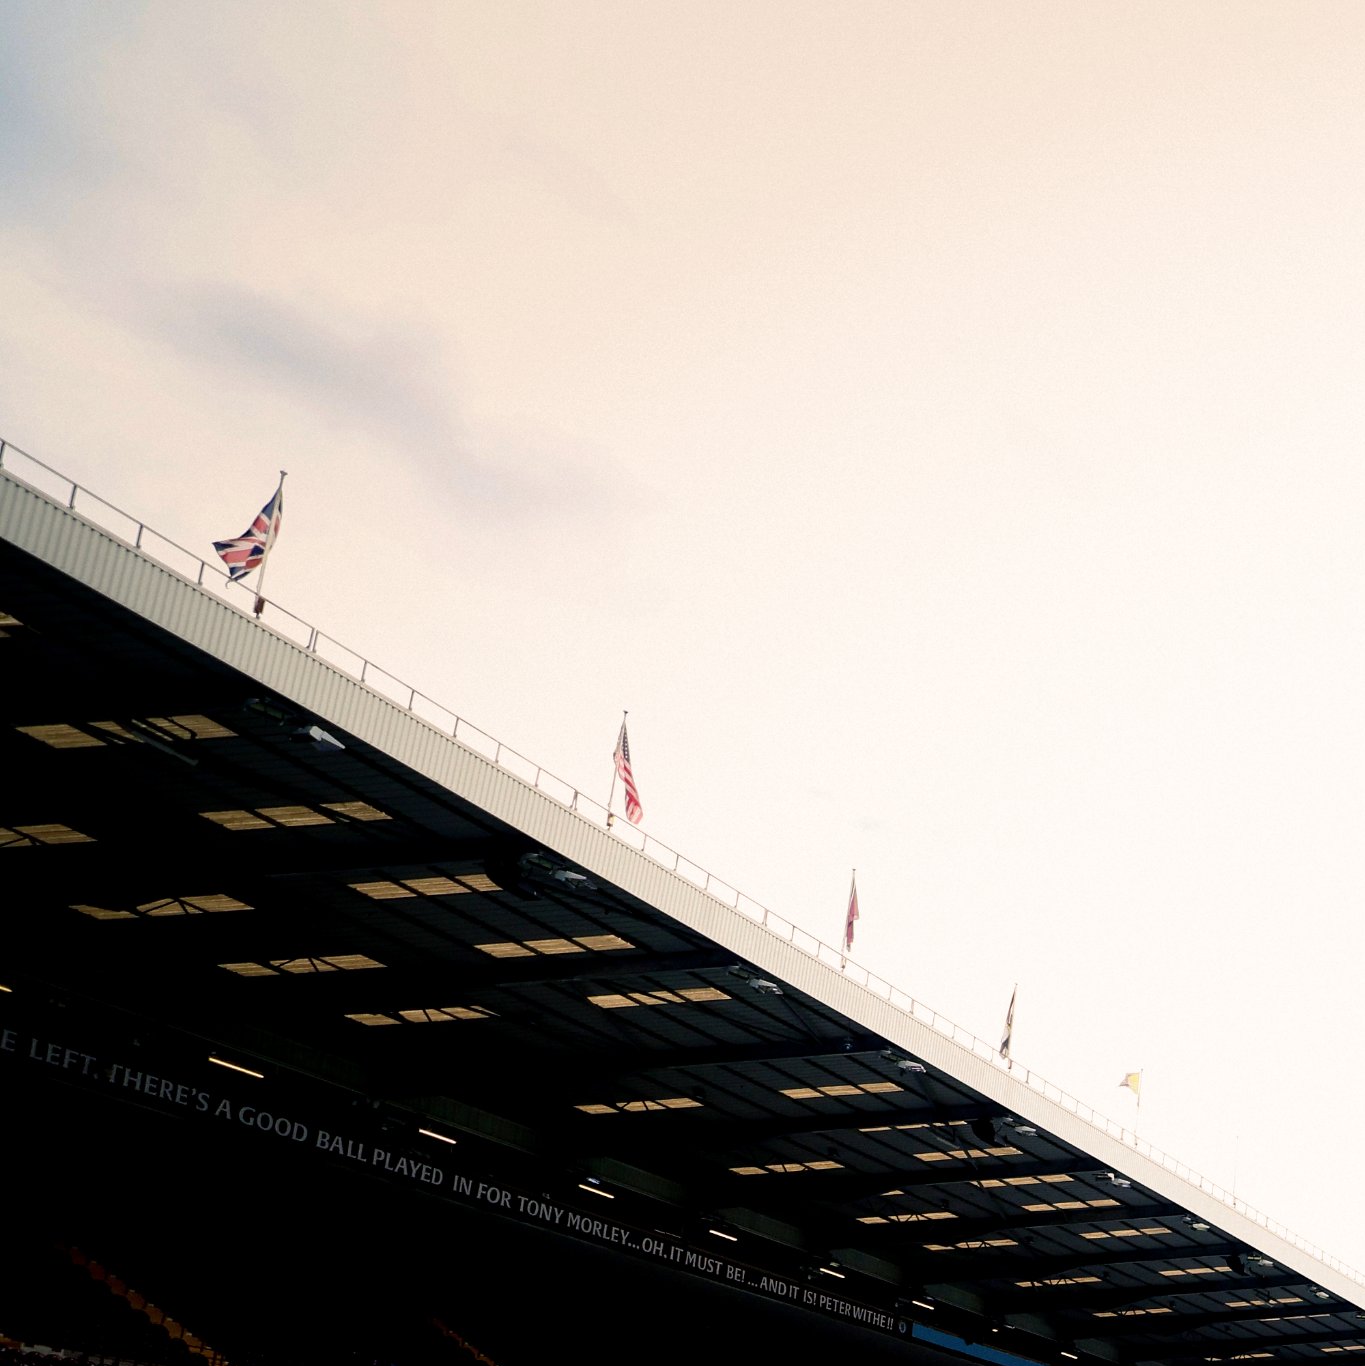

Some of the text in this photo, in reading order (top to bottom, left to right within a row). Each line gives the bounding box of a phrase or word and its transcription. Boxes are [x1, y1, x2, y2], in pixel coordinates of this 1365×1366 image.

[108, 1063, 210, 1112] THERE'S
[214, 1099, 232, 1120] A
[238, 1106, 308, 1142] GOOD
[315, 1130, 367, 1162] BALL
[372, 1149, 443, 1185] PLAYED
[452, 1174, 473, 1195] IN
[477, 1183, 511, 1208] FOR
[517, 1196, 564, 1224] TONY
[670, 1245, 684, 1262] IT
[685, 1251, 723, 1275] MUST
[726, 1264, 746, 1283] BE!
[789, 1287, 800, 1300] IT
[803, 1289, 817, 1306] IS!
[820, 1294, 851, 1317] PETER
[852, 1305, 894, 1331] WITHE!!
